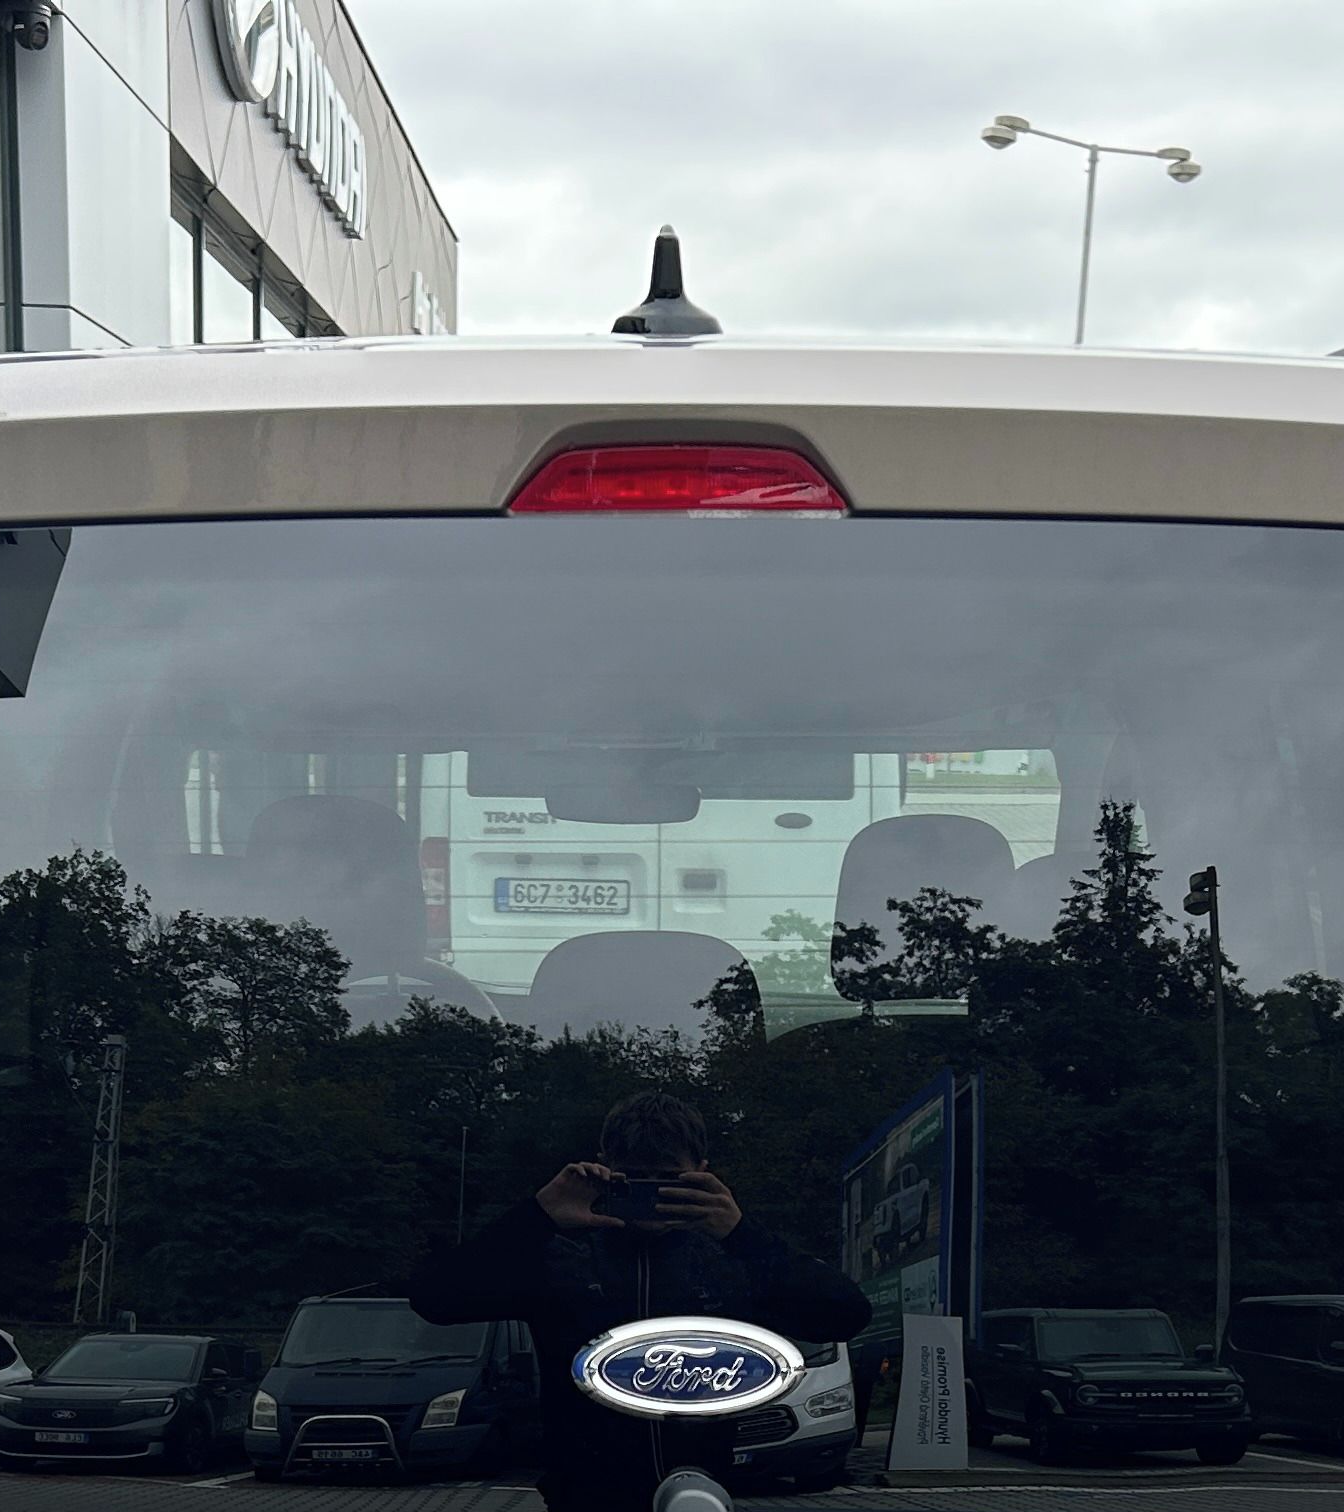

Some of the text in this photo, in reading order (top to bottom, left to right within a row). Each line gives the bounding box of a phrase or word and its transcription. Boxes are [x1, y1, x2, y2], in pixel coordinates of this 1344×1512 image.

[514, 883, 619, 906] 6C7 3462
[632, 1344, 745, 1394] Ford
